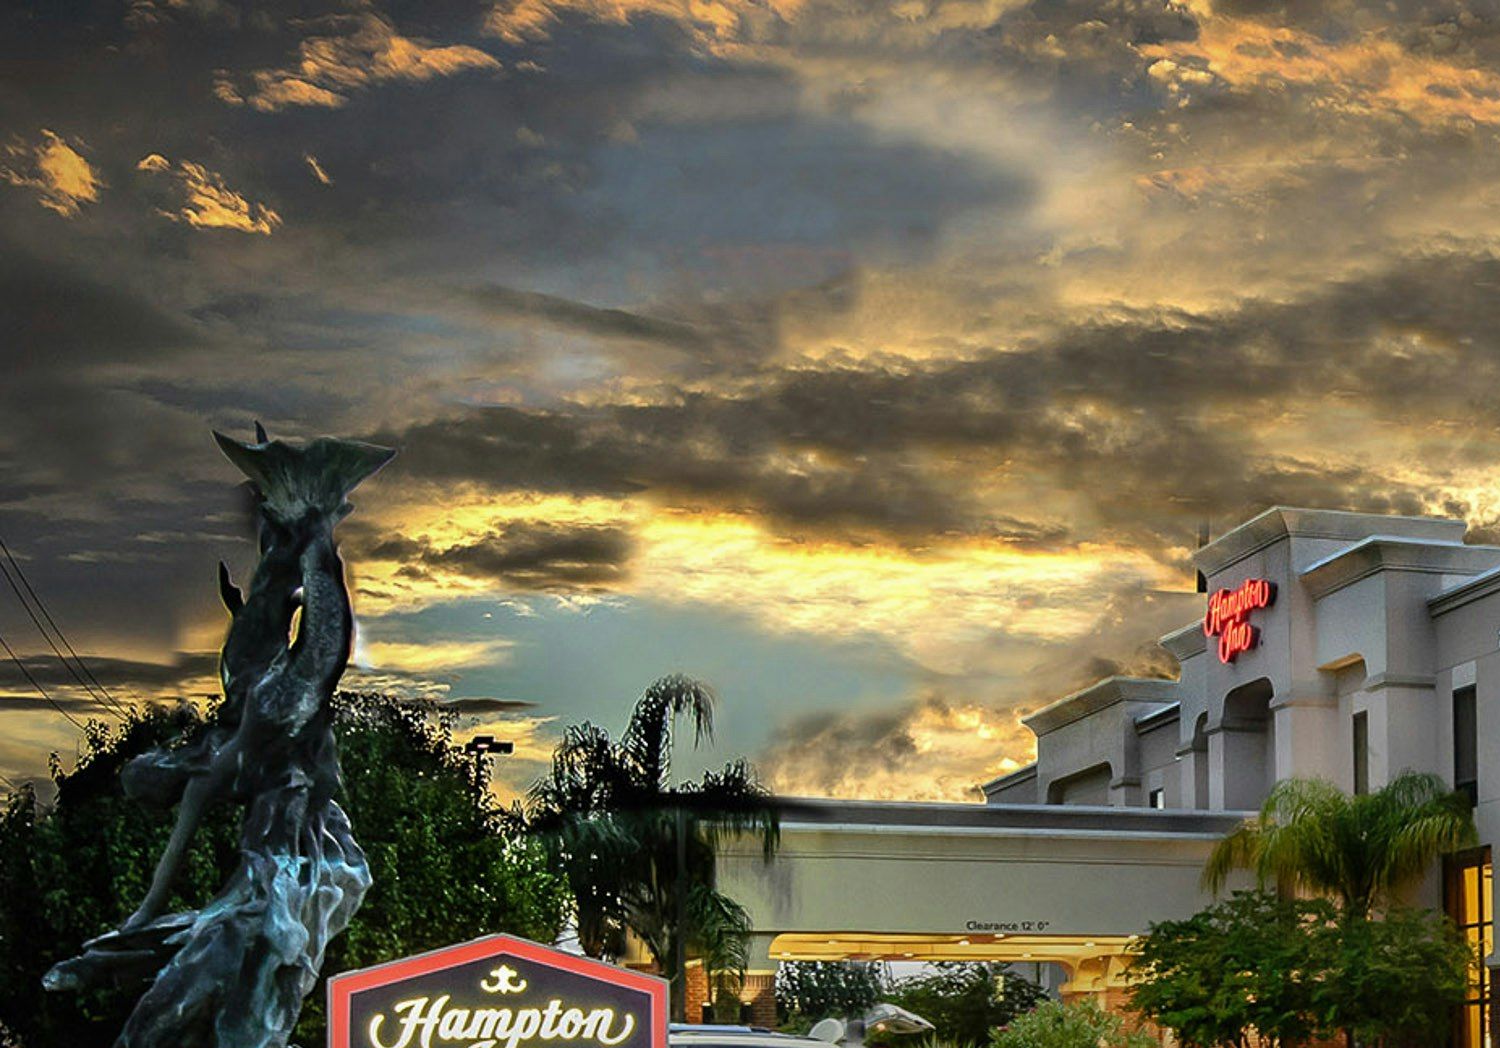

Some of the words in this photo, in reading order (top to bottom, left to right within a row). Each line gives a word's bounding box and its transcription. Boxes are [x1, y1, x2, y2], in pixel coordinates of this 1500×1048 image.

[1204, 577, 1270, 637] Hampton
[1218, 620, 1254, 664] Inn
[966, 920, 1018, 931] Clearance
